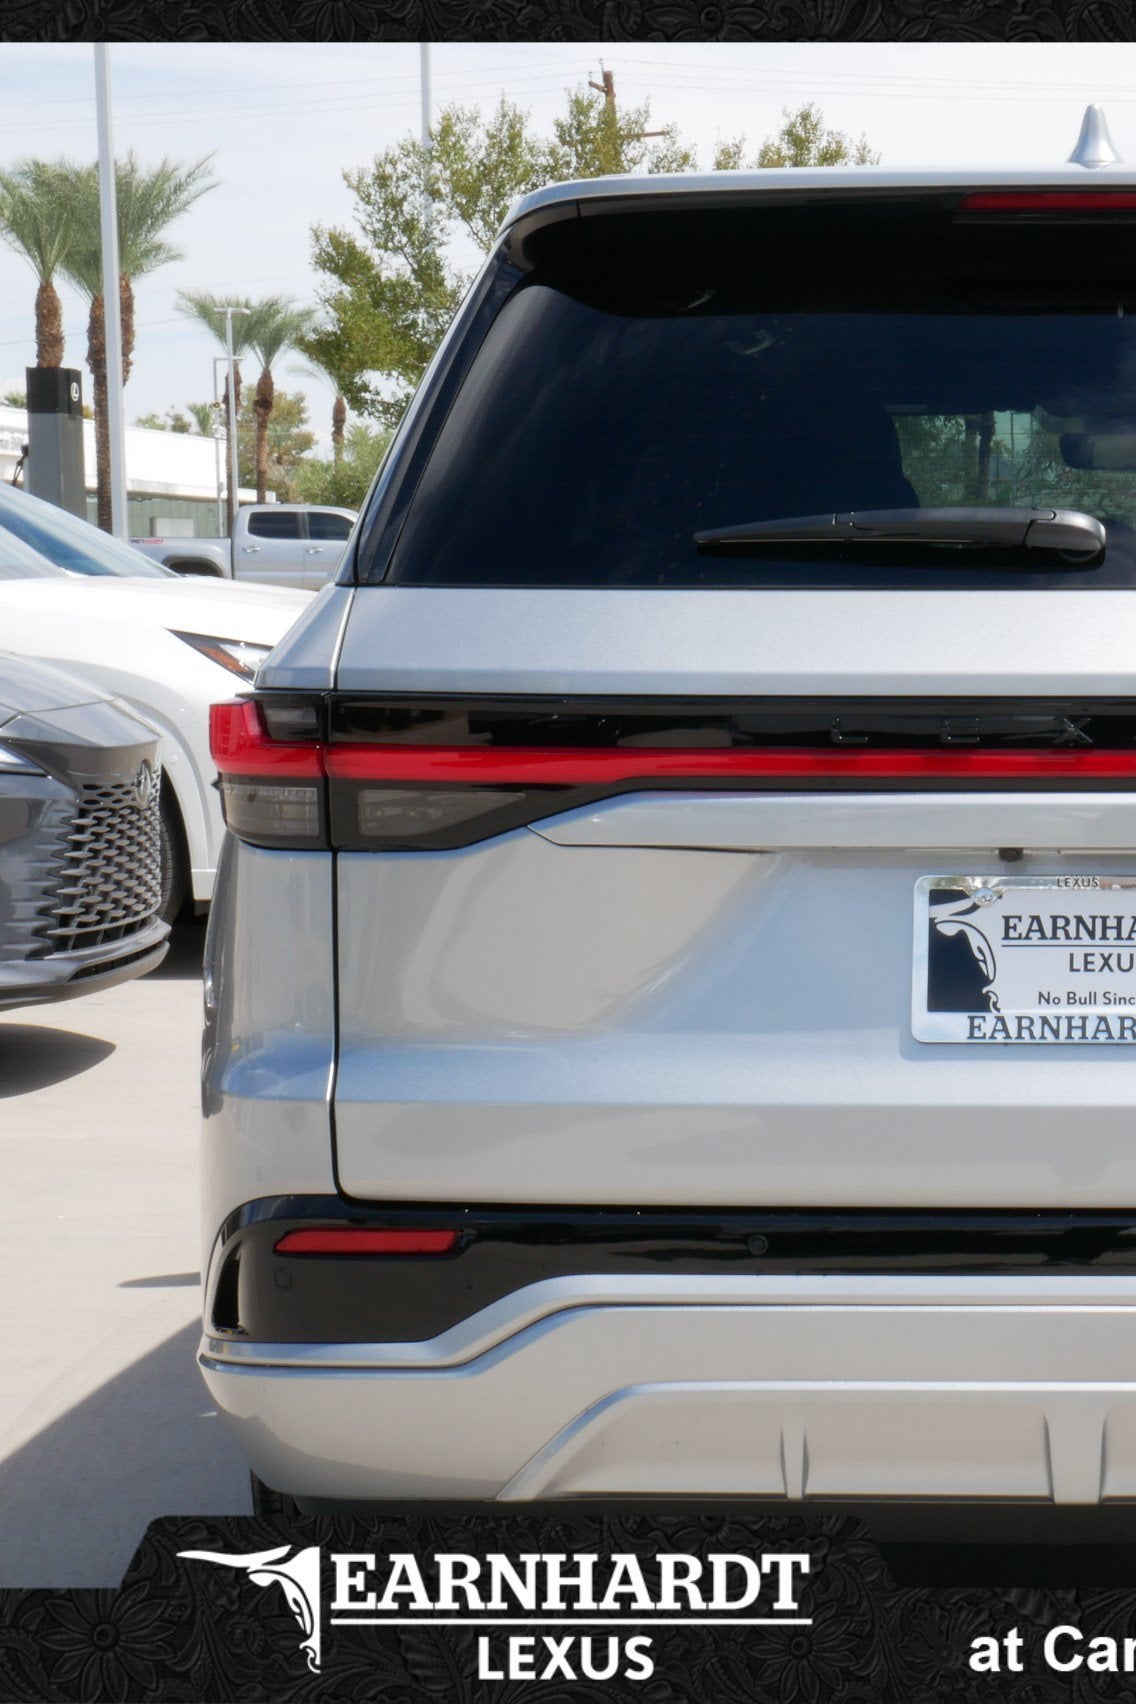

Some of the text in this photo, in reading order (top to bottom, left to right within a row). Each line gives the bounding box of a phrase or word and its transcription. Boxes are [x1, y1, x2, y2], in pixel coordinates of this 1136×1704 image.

[1056, 876, 1099, 888] LEXUS
[1038, 991, 1061, 1005] No
[1066, 991, 1097, 1006] Bull
